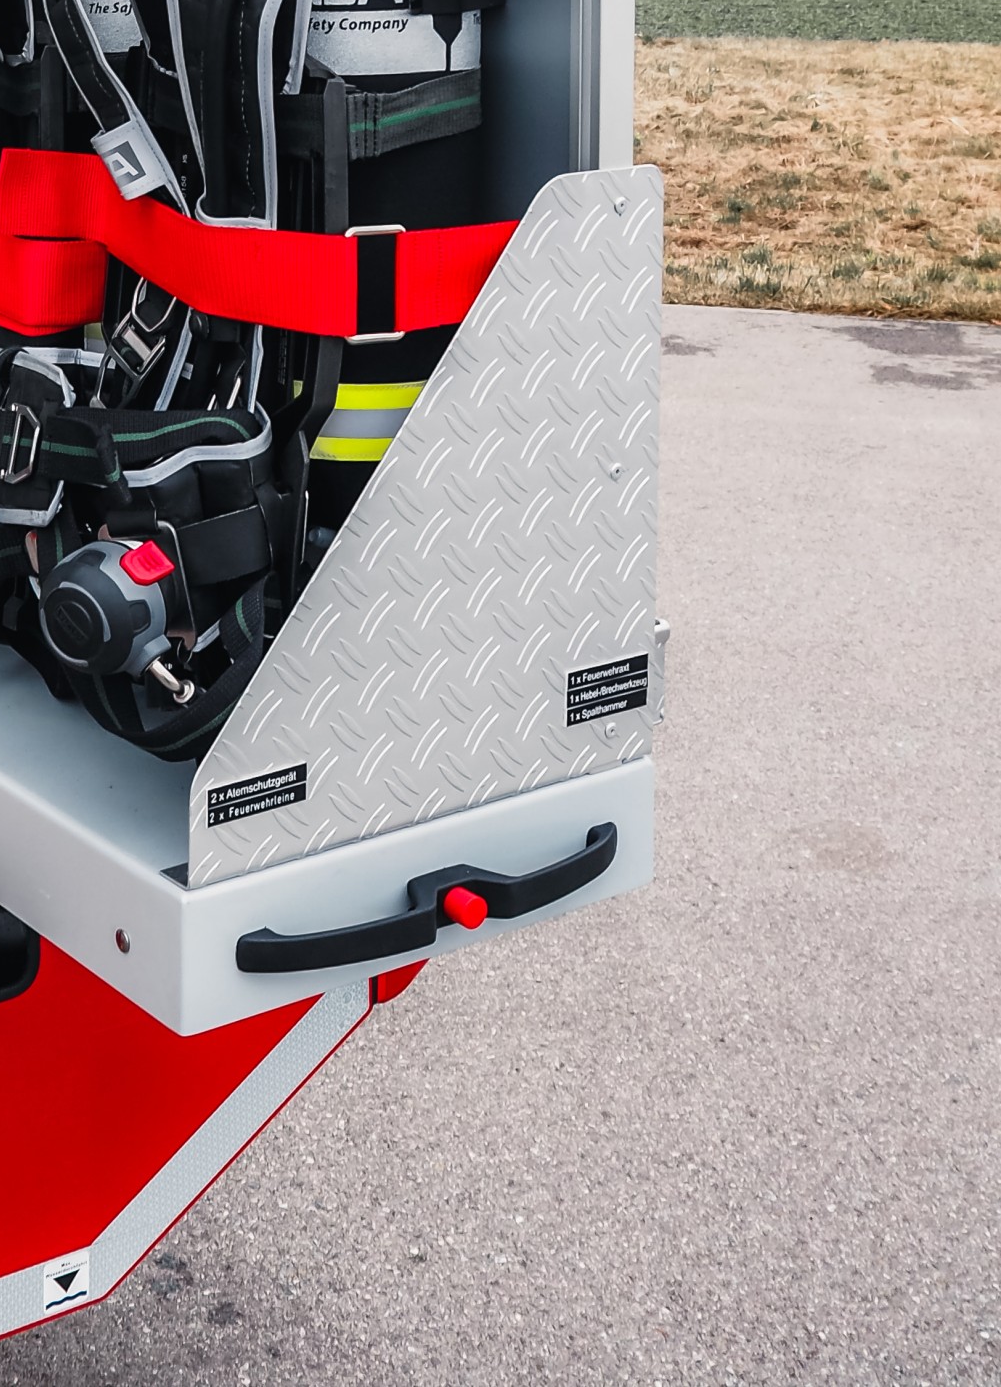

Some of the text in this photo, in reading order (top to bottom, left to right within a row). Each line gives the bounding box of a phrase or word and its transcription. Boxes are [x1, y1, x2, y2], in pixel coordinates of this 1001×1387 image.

[88, 2, 110, 15] The
[339, 17, 409, 34] Company
[582, 662, 630, 683] Feuerwehraxt
[581, 699, 628, 719] Spalthammer
[211, 771, 297, 804] 2 x Atemschutzgerät
[209, 792, 295, 824] 2 x Feuerwehrleine
